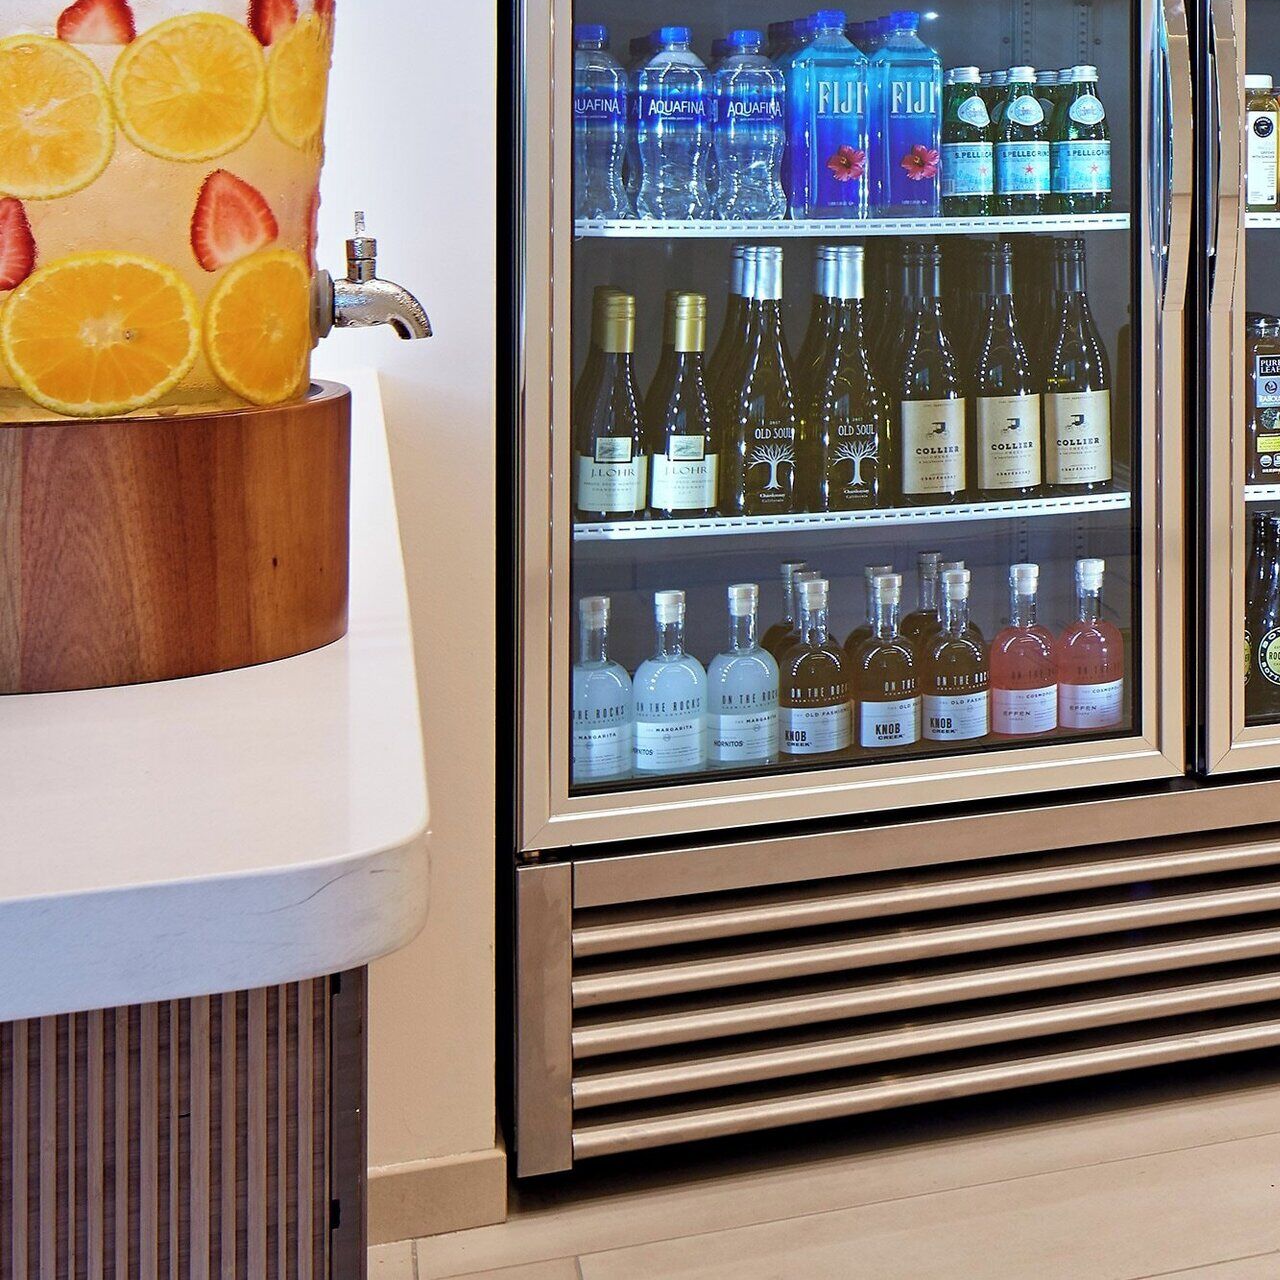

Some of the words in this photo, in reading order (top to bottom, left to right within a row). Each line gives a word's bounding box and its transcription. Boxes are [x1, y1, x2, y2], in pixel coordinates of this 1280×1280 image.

[818, 82, 863, 114] FIJI
[891, 82, 936, 114] FIJI
[649, 99, 705, 115] AQUAFINA
[727, 101, 782, 117] AQUAFINA
[755, 429, 771, 439] OLD
[774, 428, 793, 439] SOUL
[838, 425, 854, 436] OLD
[856, 424, 875, 435] SOUL
[991, 442, 1033, 450] COLLIER
[1056, 437, 1100, 446] COLLIER
[916, 446, 959, 455] COLLIER
[884, 682, 895, 692] ON
[902, 678, 915, 690] THE
[937, 676, 947, 686] ON
[953, 675, 969, 685] THE
[791, 688, 805, 698] ON
[808, 687, 824, 697] THE
[650, 702, 665, 713] THE
[672, 698, 700, 711] ROCKS
[722, 695, 732, 705] ON
[739, 694, 756, 704] THE
[595, 705, 624, 719] ROCKS
[875, 723, 901, 735] KNOB
[930, 717, 952, 729] KNOB
[578, 732, 617, 740] MARGARITA
[785, 730, 807, 741] KNOB
